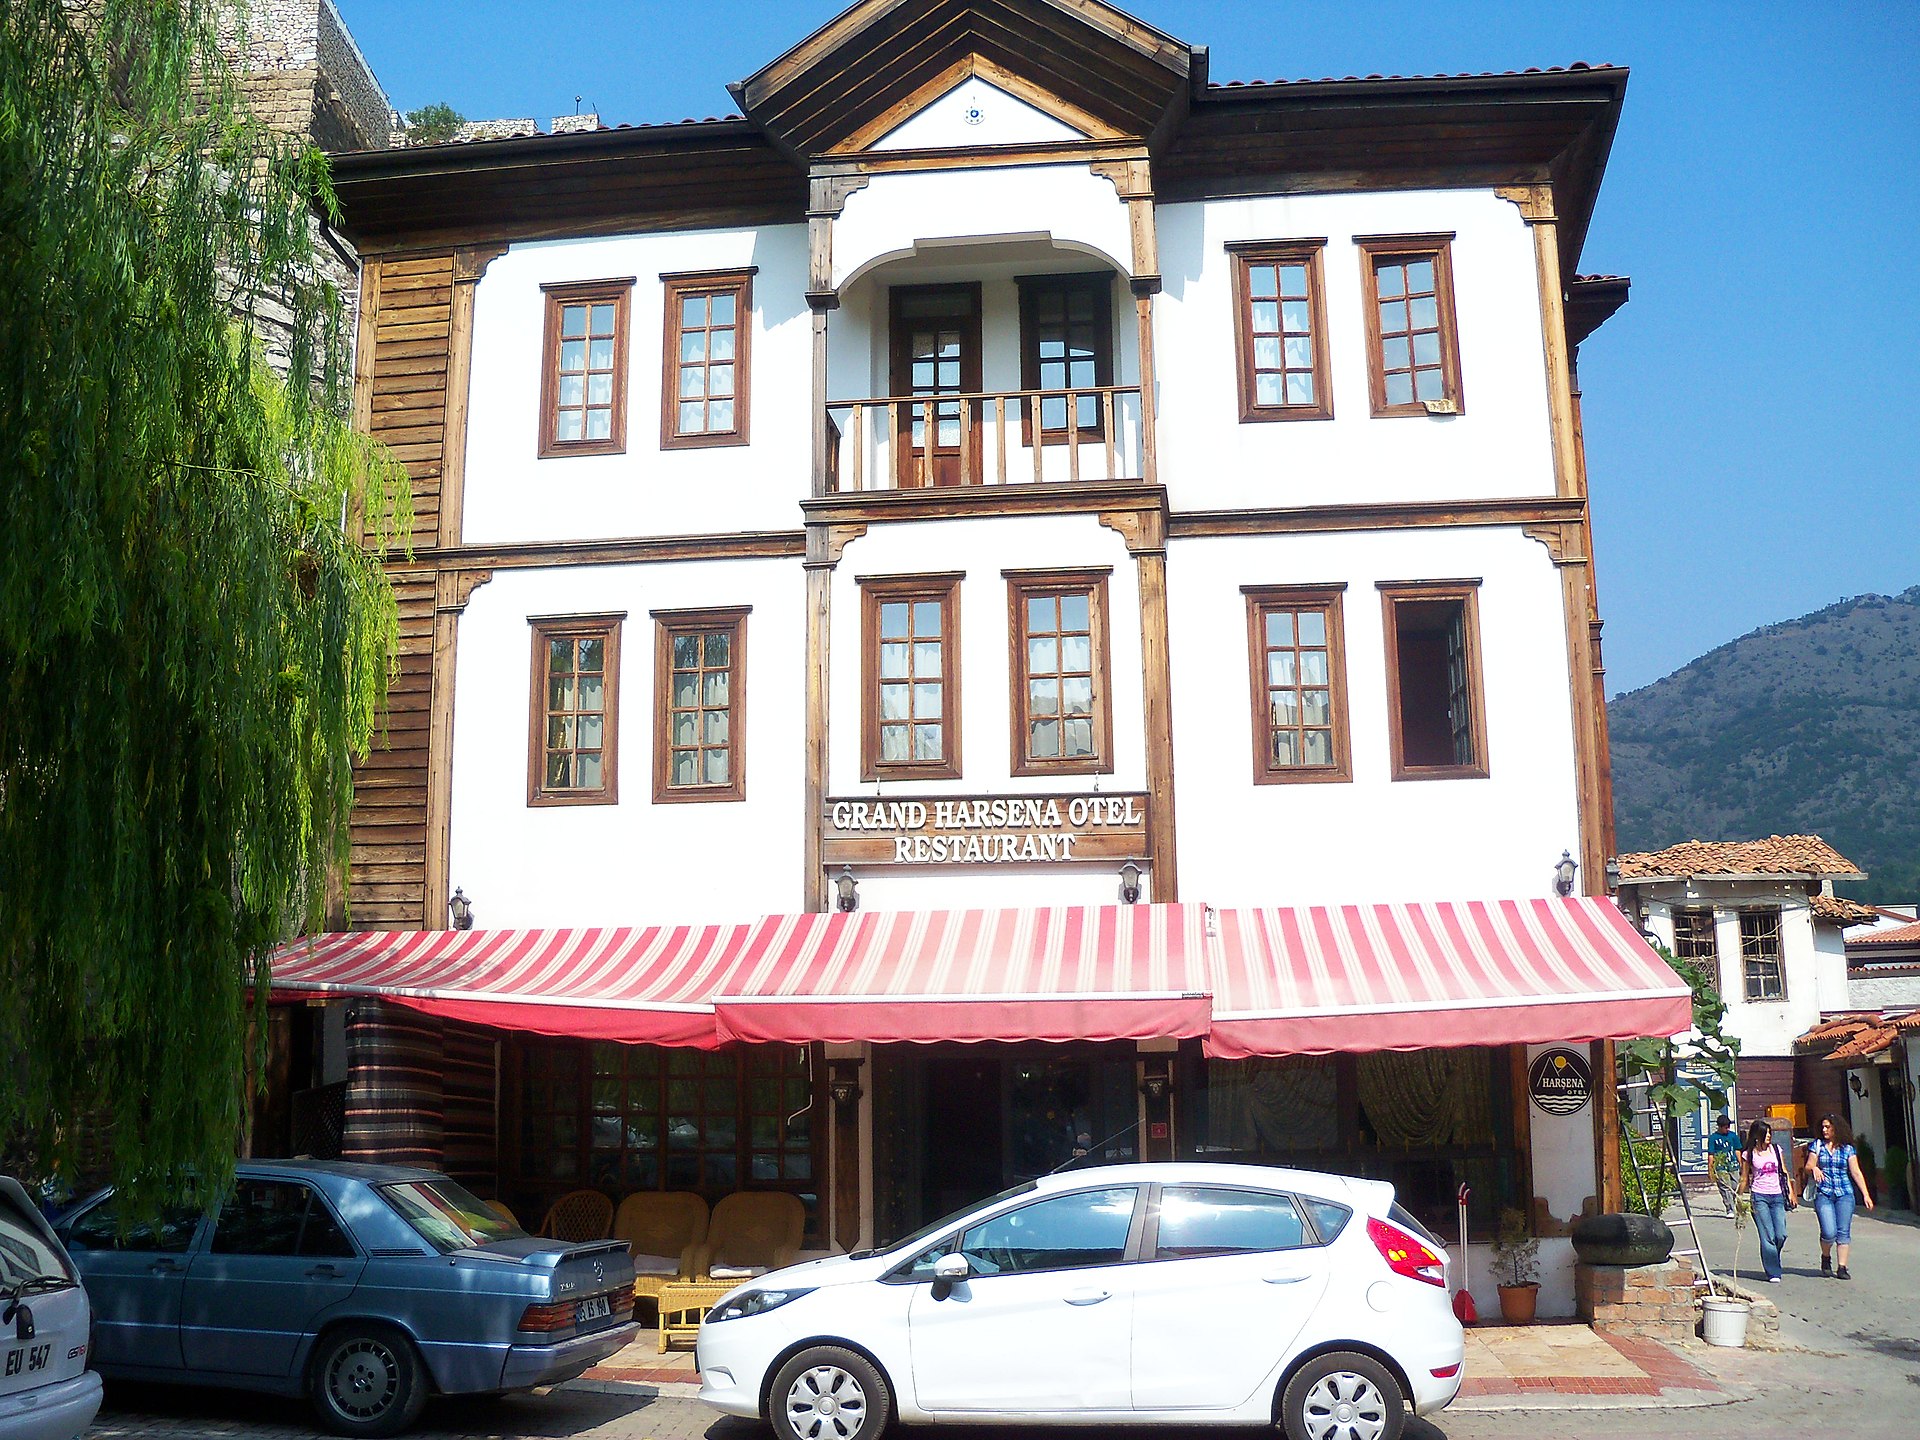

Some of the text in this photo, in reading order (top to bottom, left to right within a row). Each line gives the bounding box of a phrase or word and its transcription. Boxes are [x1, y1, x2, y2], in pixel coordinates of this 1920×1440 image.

[832, 797, 1142, 830] GRAND HARSENA OTEL
[894, 833, 1076, 863] RESTAURANT
[1542, 1078, 1584, 1089] HARŞENA
[5, 1343, 51, 1376] EU 547
